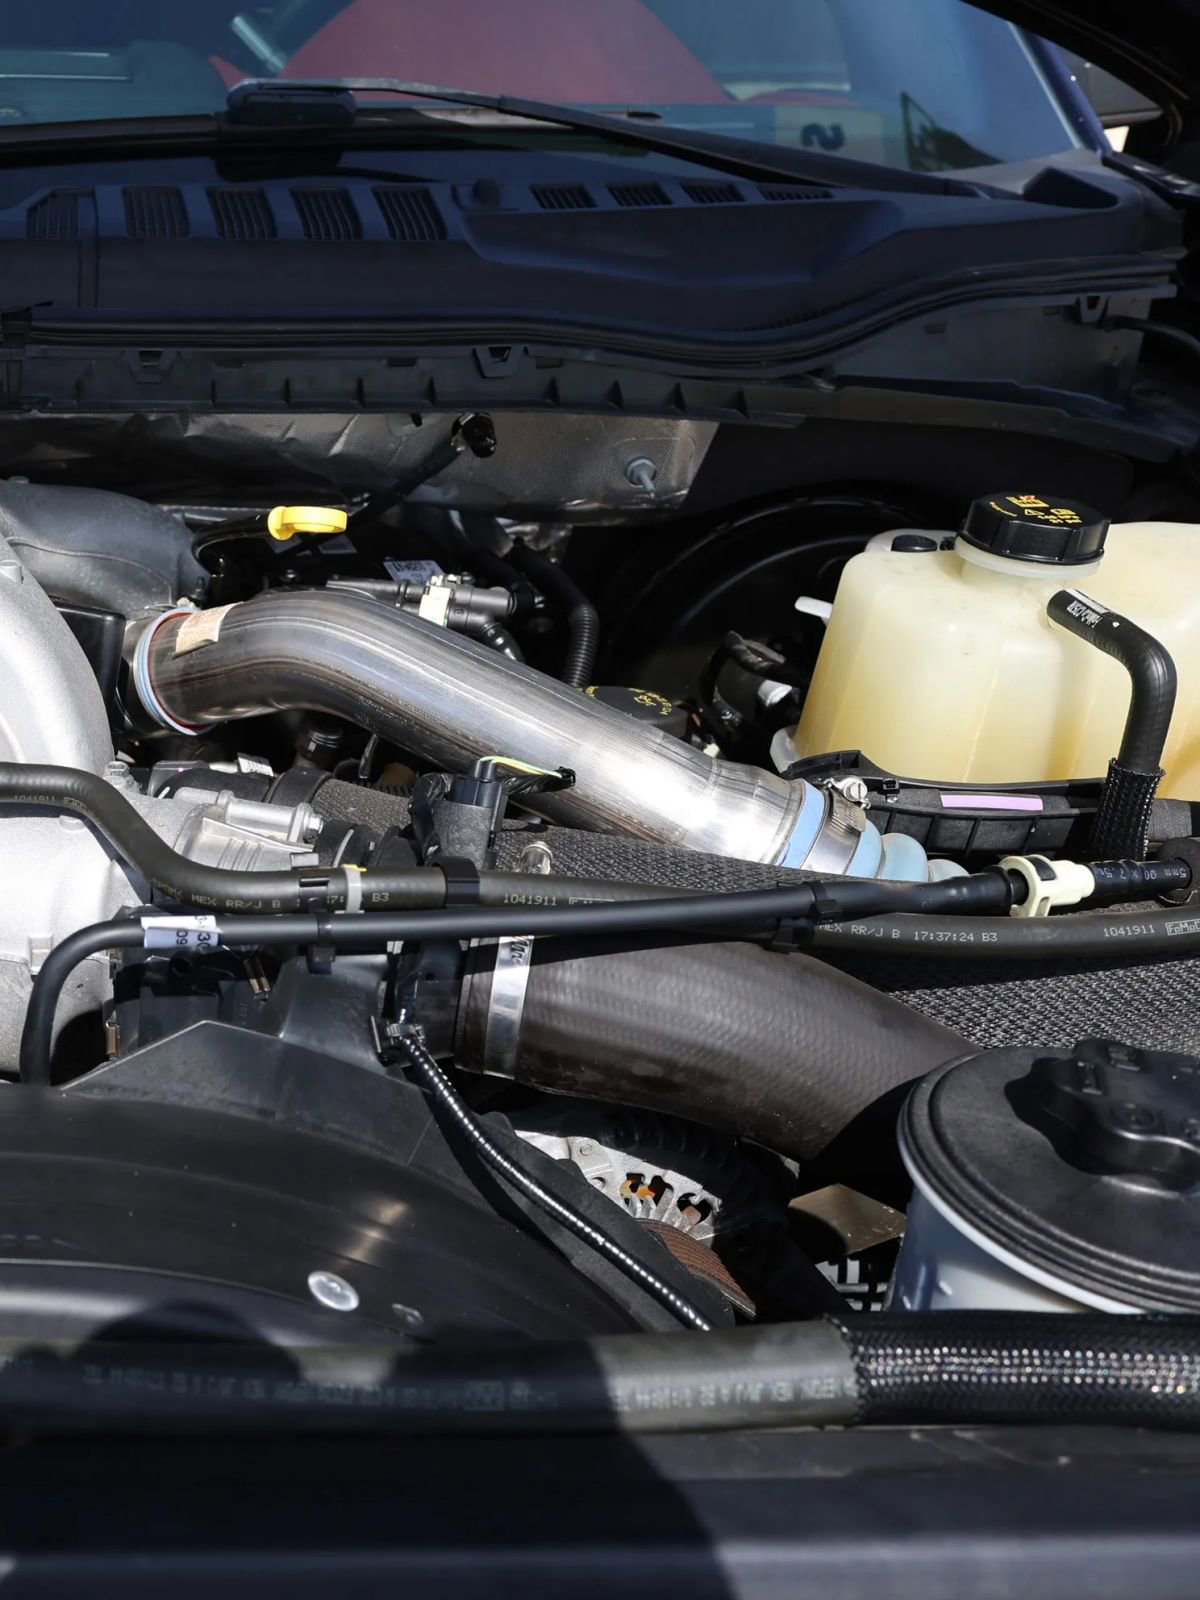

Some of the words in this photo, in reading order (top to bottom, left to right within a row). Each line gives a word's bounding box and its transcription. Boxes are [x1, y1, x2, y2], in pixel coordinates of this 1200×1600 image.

[191, 893, 217, 906] MEX
[225, 900, 262, 909] RR/J
[371, 892, 390, 903] B3
[503, 893, 557, 906] 1041911
[850, 925, 883, 937] RR/J
[913, 930, 975, 942] 17:37:24
[981, 932, 998, 942] B3
[1103, 924, 1156, 938] 1041911
